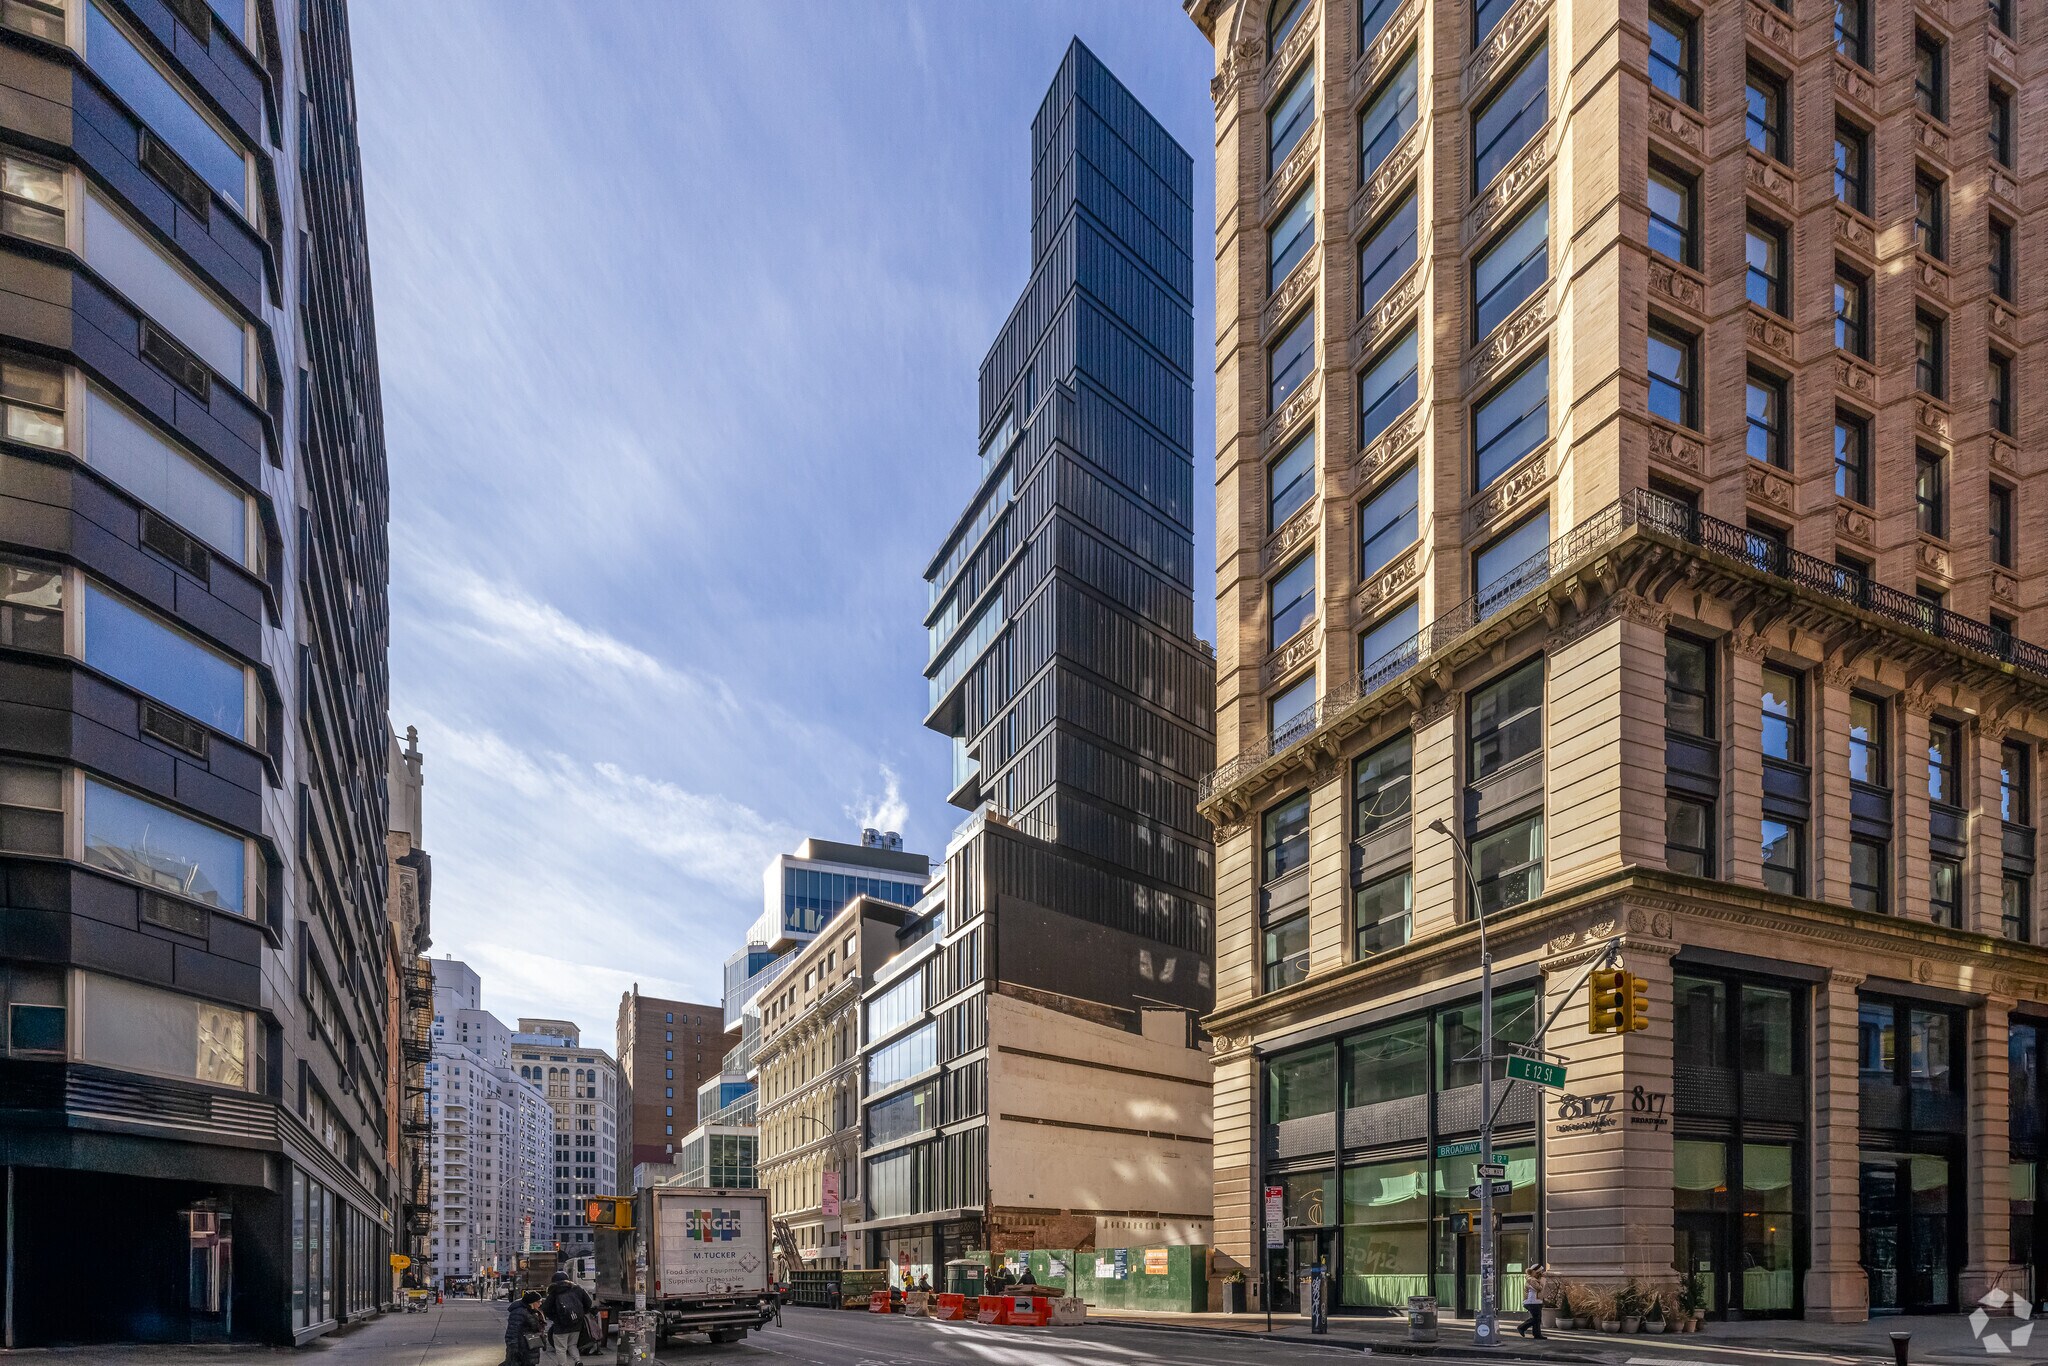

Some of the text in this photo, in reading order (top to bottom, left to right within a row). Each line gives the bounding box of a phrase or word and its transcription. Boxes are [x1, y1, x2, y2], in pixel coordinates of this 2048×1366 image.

[1524, 1063, 1553, 1082] E 12 St
[1558, 1094, 1611, 1130] 817
[1632, 1085, 1667, 1130] 817
[1631, 1117, 1668, 1125] BROADWAY
[1440, 1143, 1478, 1156] BROADWAY
[1492, 1154, 1496, 1163] E
[1497, 1155, 1503, 1164] 12
[685, 1218, 741, 1230] SINGER
[668, 1277, 697, 1285] Supplies
